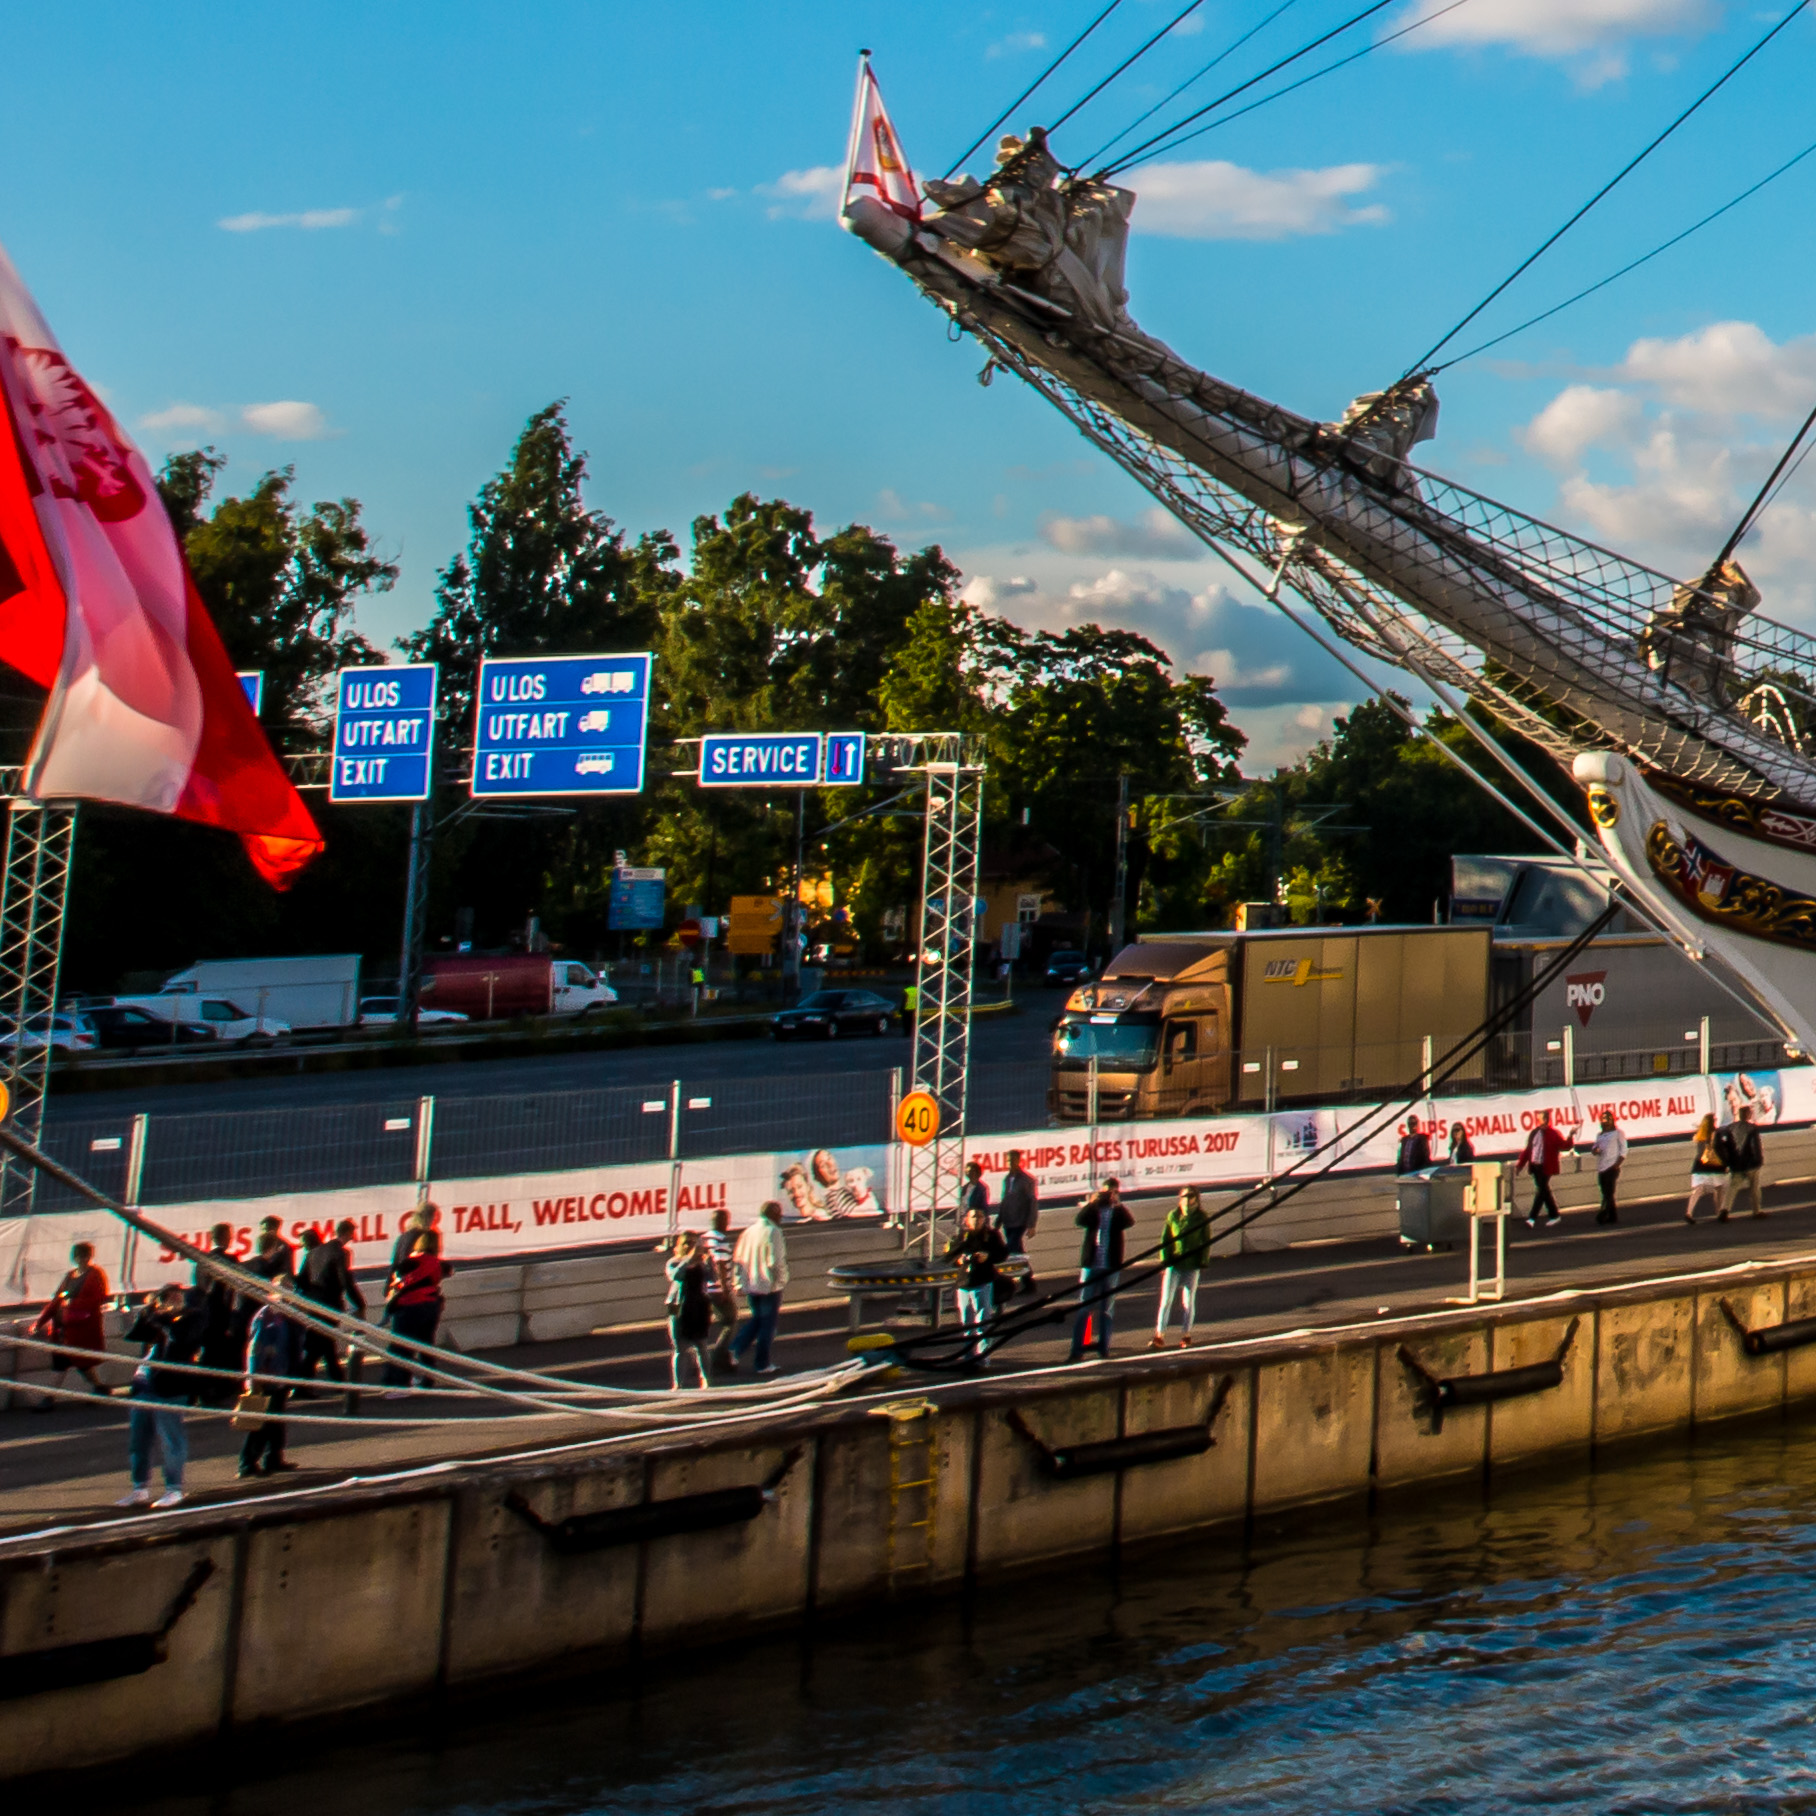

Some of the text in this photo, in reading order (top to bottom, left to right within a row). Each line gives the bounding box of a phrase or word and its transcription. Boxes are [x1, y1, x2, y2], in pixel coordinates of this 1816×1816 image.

[347, 682, 400, 709] ULOS
[491, 674, 547, 701] ULOS
[343, 718, 424, 747] UTFART
[488, 711, 570, 740] UTFART
[340, 758, 389, 786] EXIT
[485, 751, 535, 780] EXIT
[712, 745, 810, 774] SERVICE
[1264, 959, 1297, 977] NTC
[1567, 983, 1605, 1007] PNO
[904, 1107, 930, 1133] 40
[1466, 1113, 1517, 1137] SMALL
[1667, 1095, 1696, 1116] ALL!
[1069, 1139, 1122, 1165] RACES
[1126, 1135, 1200, 1160] TURUSSA
[1203, 1131, 1241, 1154] 2017
[452, 1203, 523, 1234] TALL,
[532, 1188, 668, 1227] WELCOME
[677, 1182, 727, 1213] ALL!
